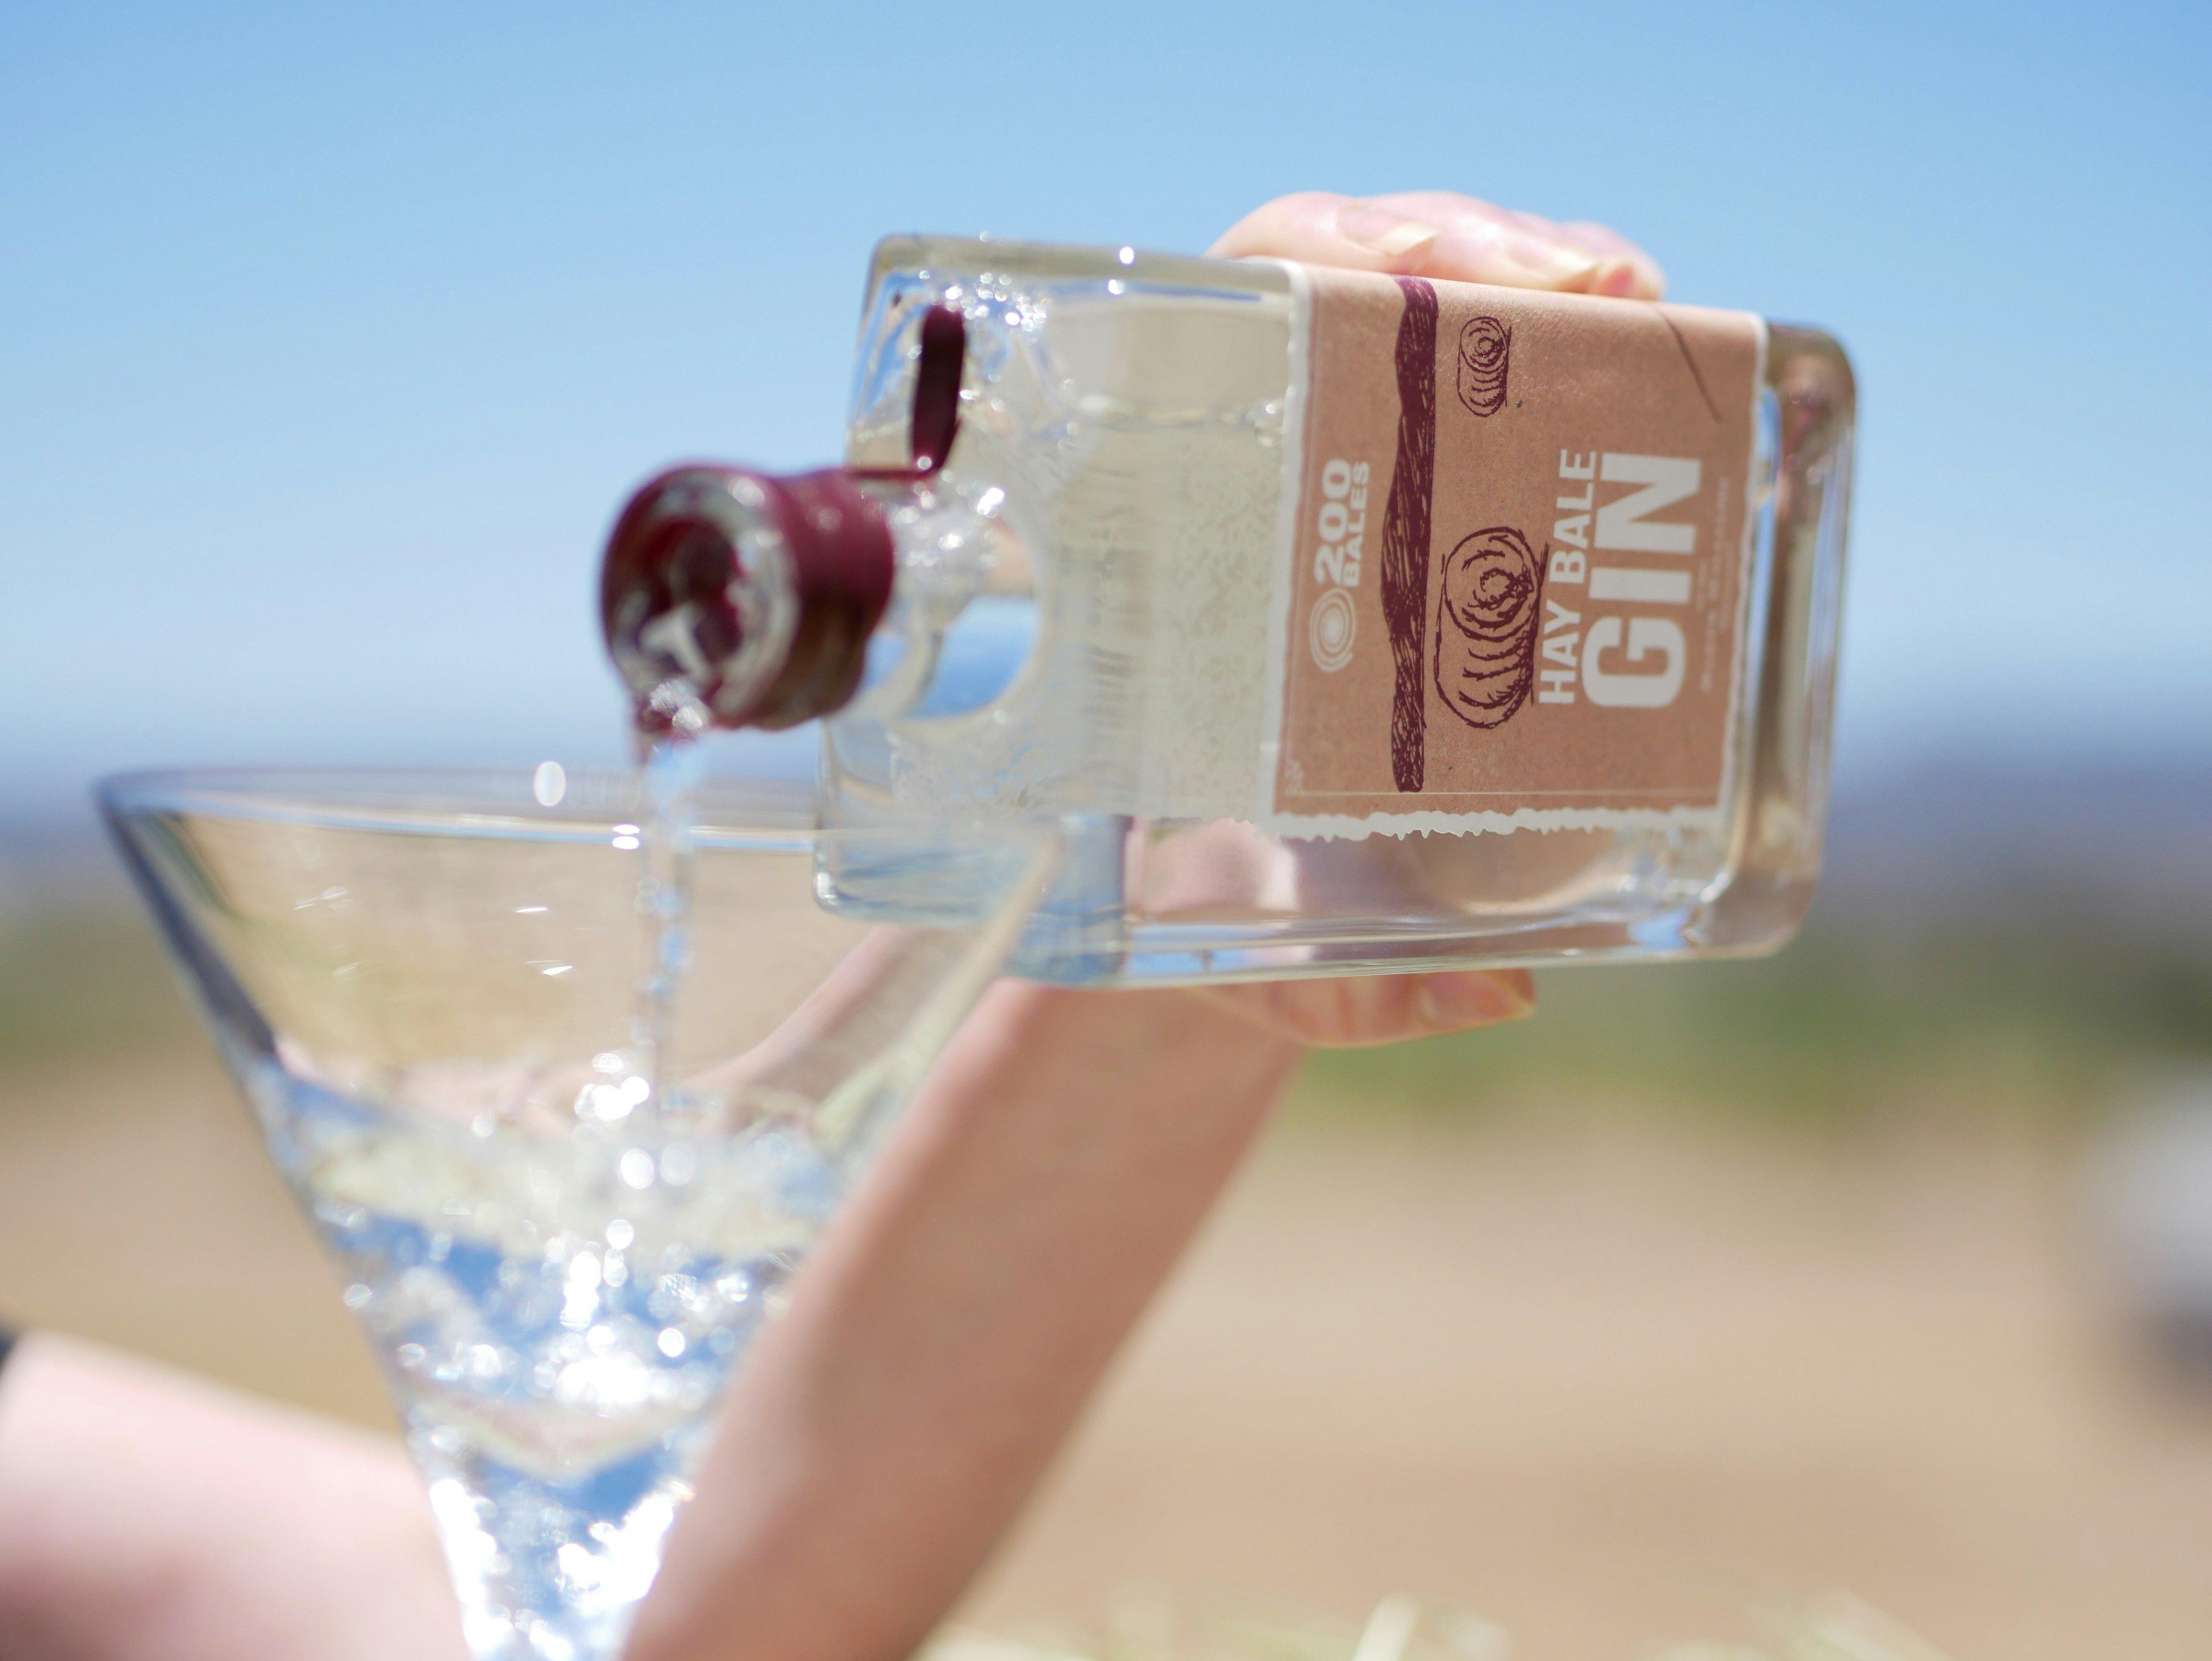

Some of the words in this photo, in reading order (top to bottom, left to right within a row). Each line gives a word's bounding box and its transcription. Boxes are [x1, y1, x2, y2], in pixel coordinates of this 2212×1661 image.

[1315, 459, 1351, 584] 200
[1344, 461, 1370, 587] BALES
[1550, 449, 1596, 585] BALE
[1581, 452, 1701, 708] GIN
[1539, 598, 1581, 704] HAY
